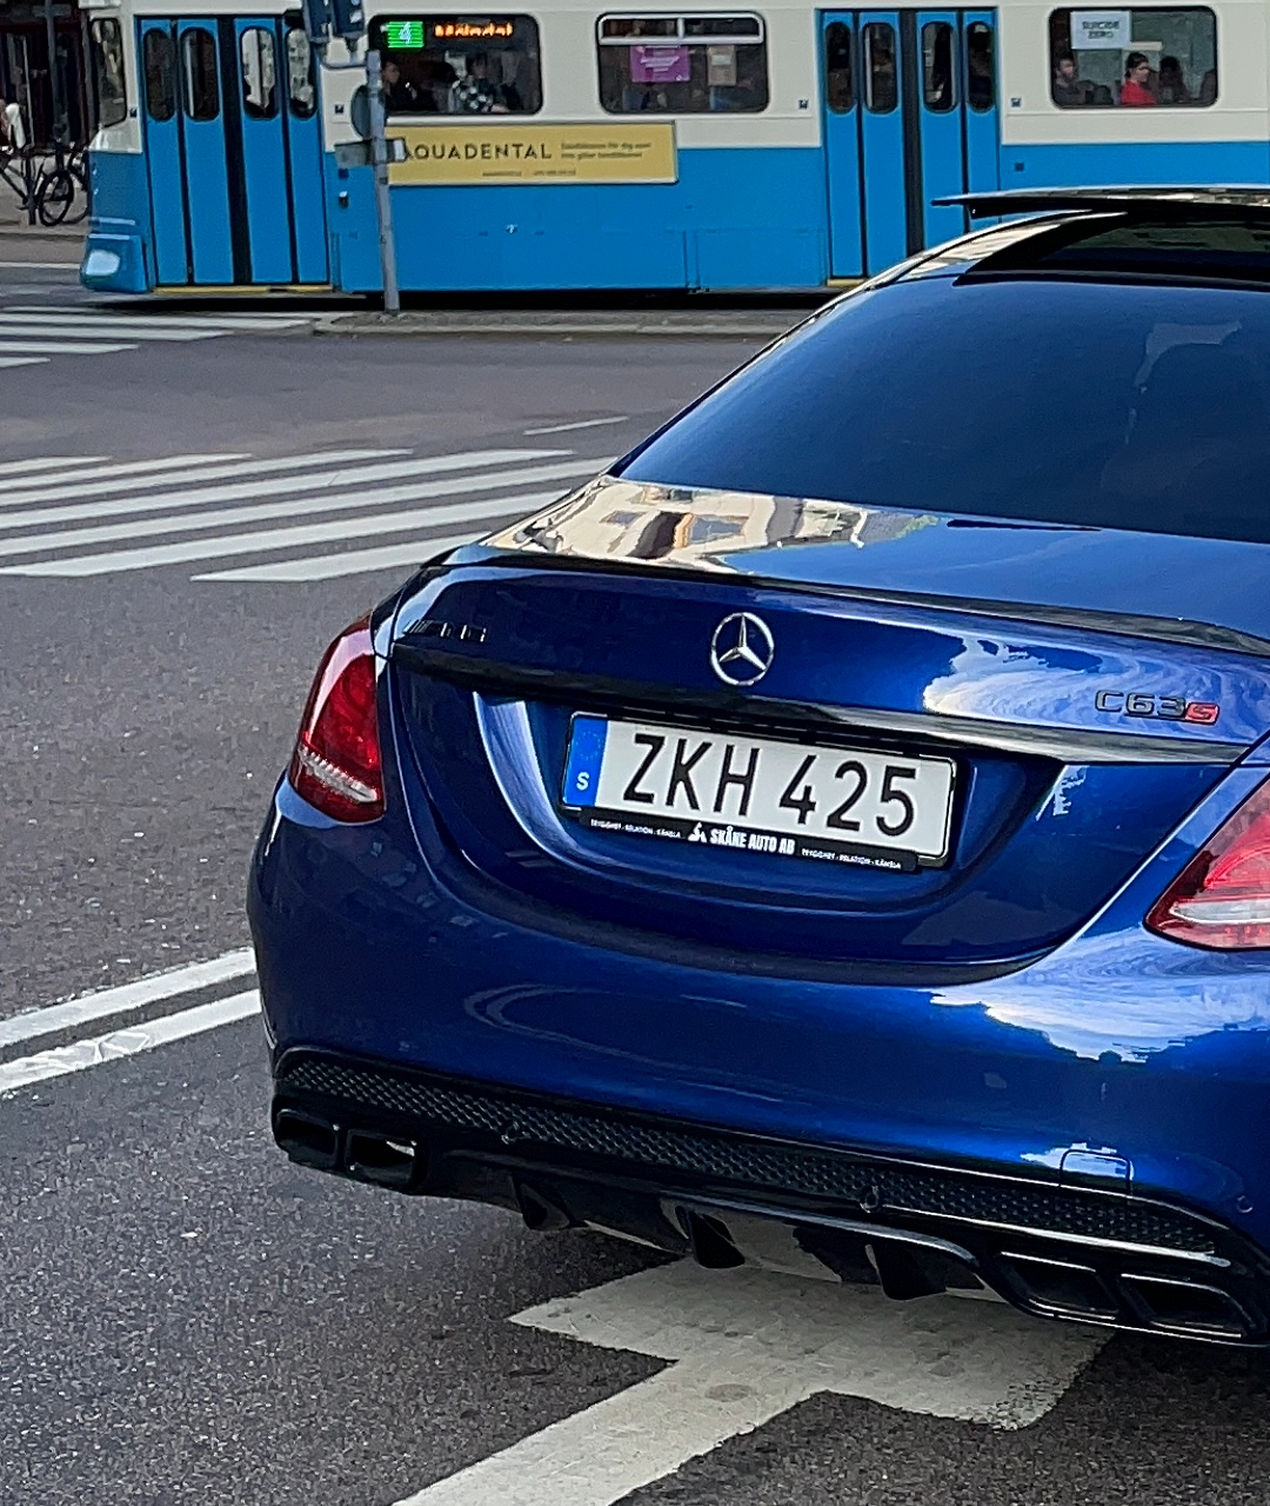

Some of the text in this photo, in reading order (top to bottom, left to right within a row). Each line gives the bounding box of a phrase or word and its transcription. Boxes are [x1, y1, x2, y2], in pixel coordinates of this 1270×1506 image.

[576, 771, 590, 791] S
[623, 733, 917, 837] ZKH 425
[710, 825, 796, 855] SKÅNE AUTO AB
